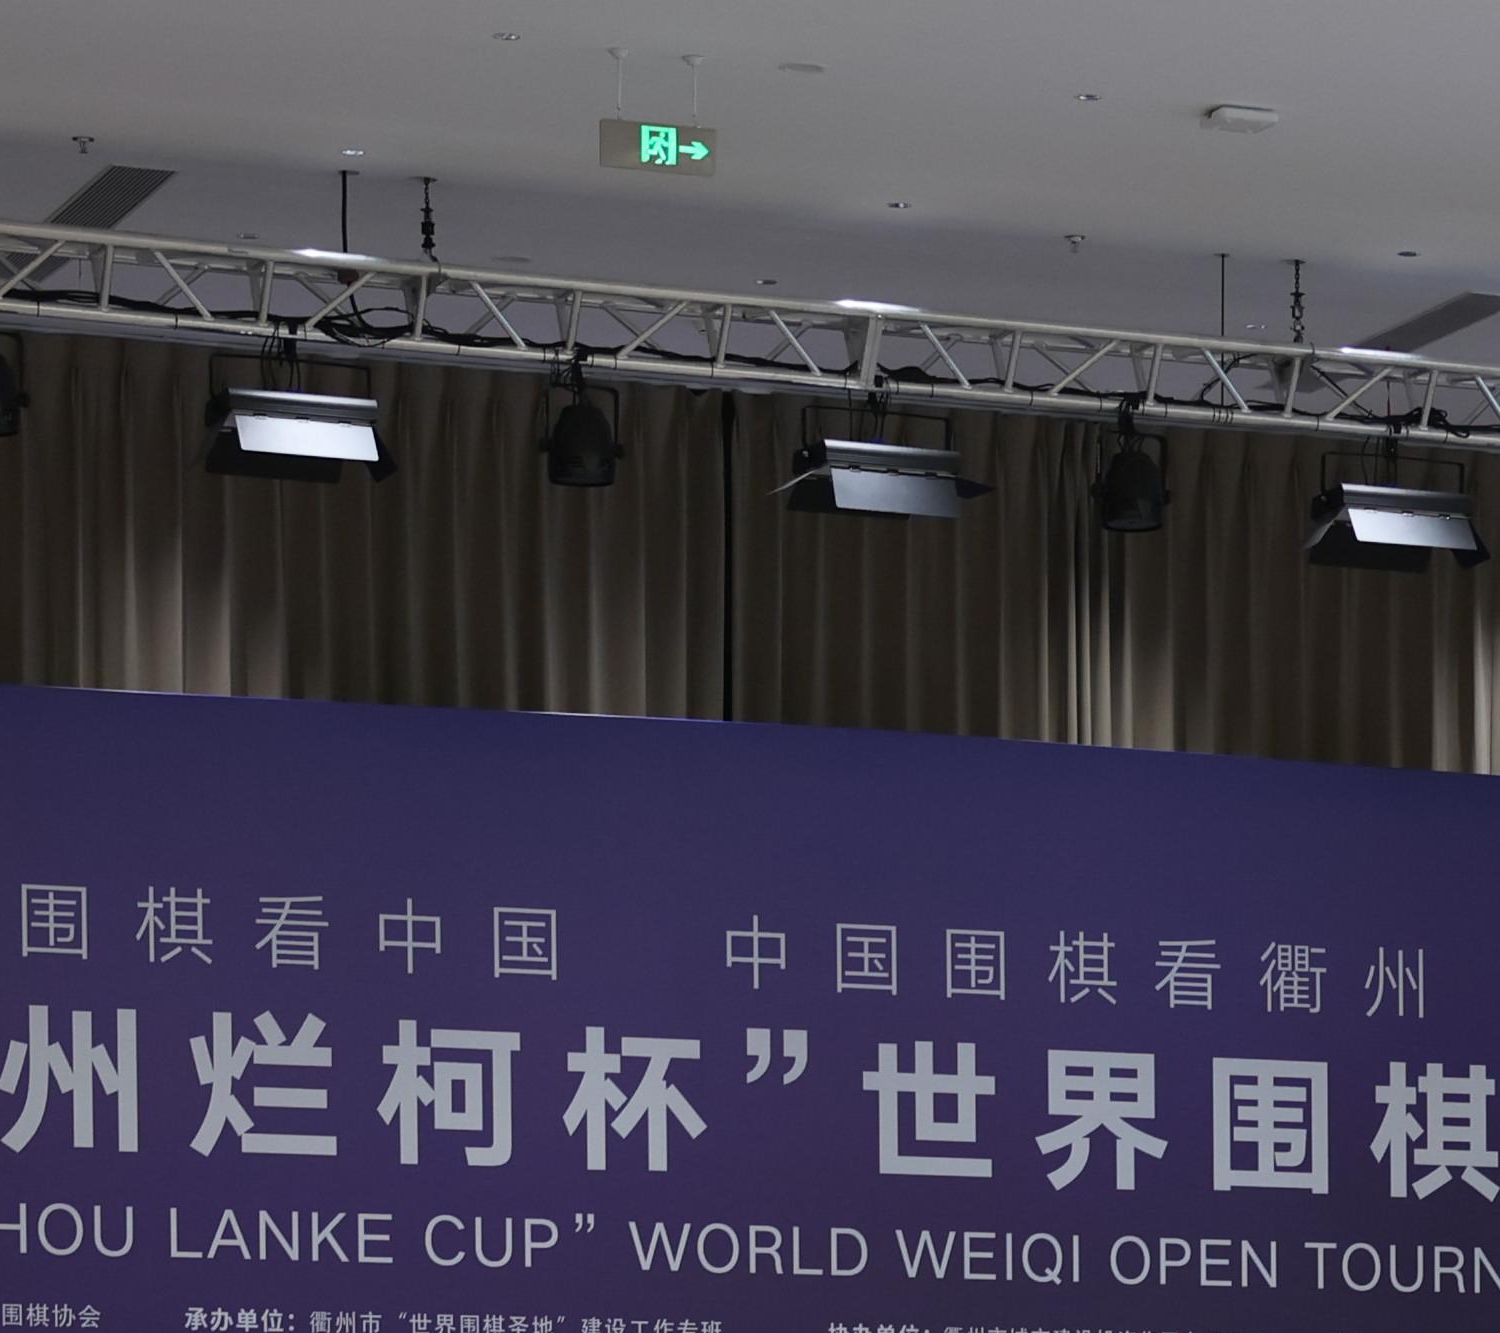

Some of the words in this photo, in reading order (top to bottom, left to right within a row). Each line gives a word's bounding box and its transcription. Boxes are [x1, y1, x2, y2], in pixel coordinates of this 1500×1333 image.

[724, 913, 1430, 1020] 中国围棋看衢州
[169, 1206, 394, 1264] LANKE
[629, 1220, 869, 1276] WORLD
[895, 1230, 1082, 1285] WEIQI
[1109, 1236, 1279, 1289] OPEN
